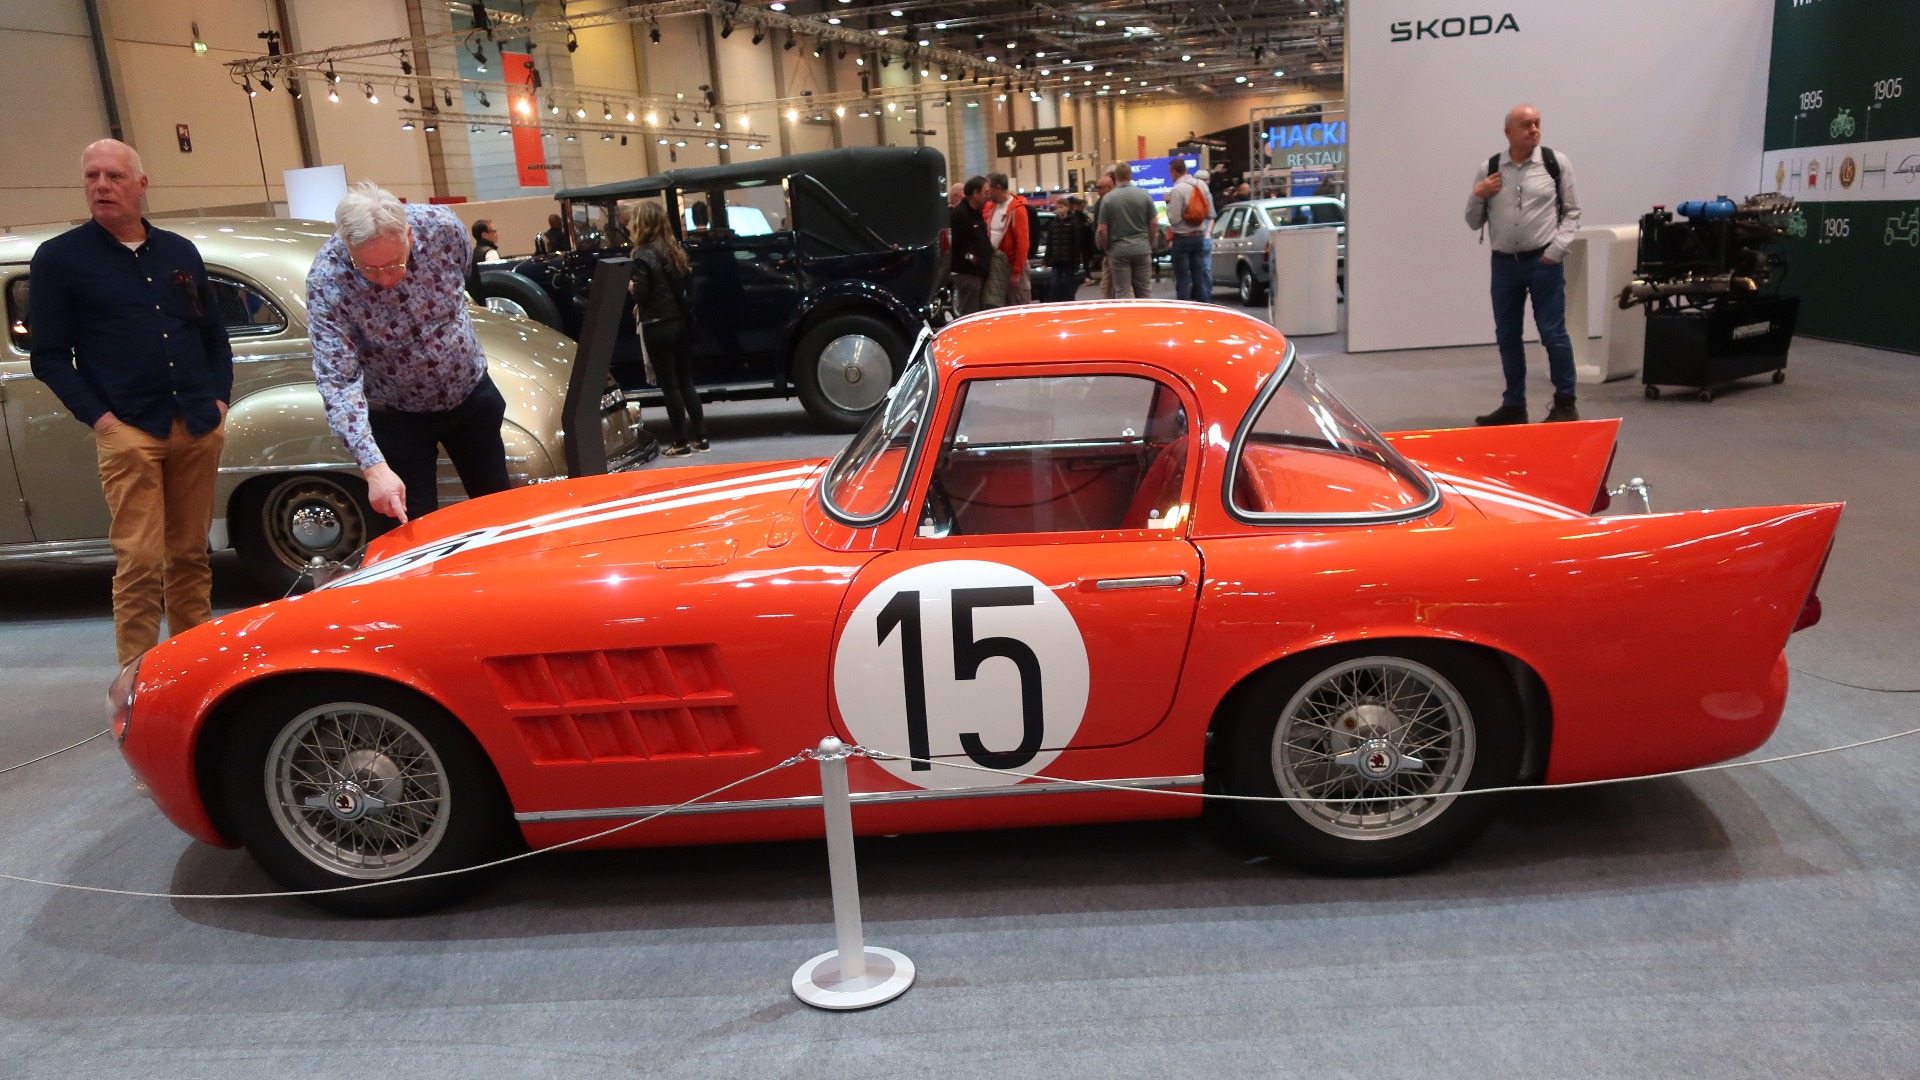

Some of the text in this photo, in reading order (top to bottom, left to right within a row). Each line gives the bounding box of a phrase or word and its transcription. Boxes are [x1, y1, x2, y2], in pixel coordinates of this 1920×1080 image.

[1873, 77, 1902, 100] 1905
[1799, 90, 1823, 110] 1895
[1824, 218, 1850, 237] 1905
[876, 585, 1044, 772] 15
